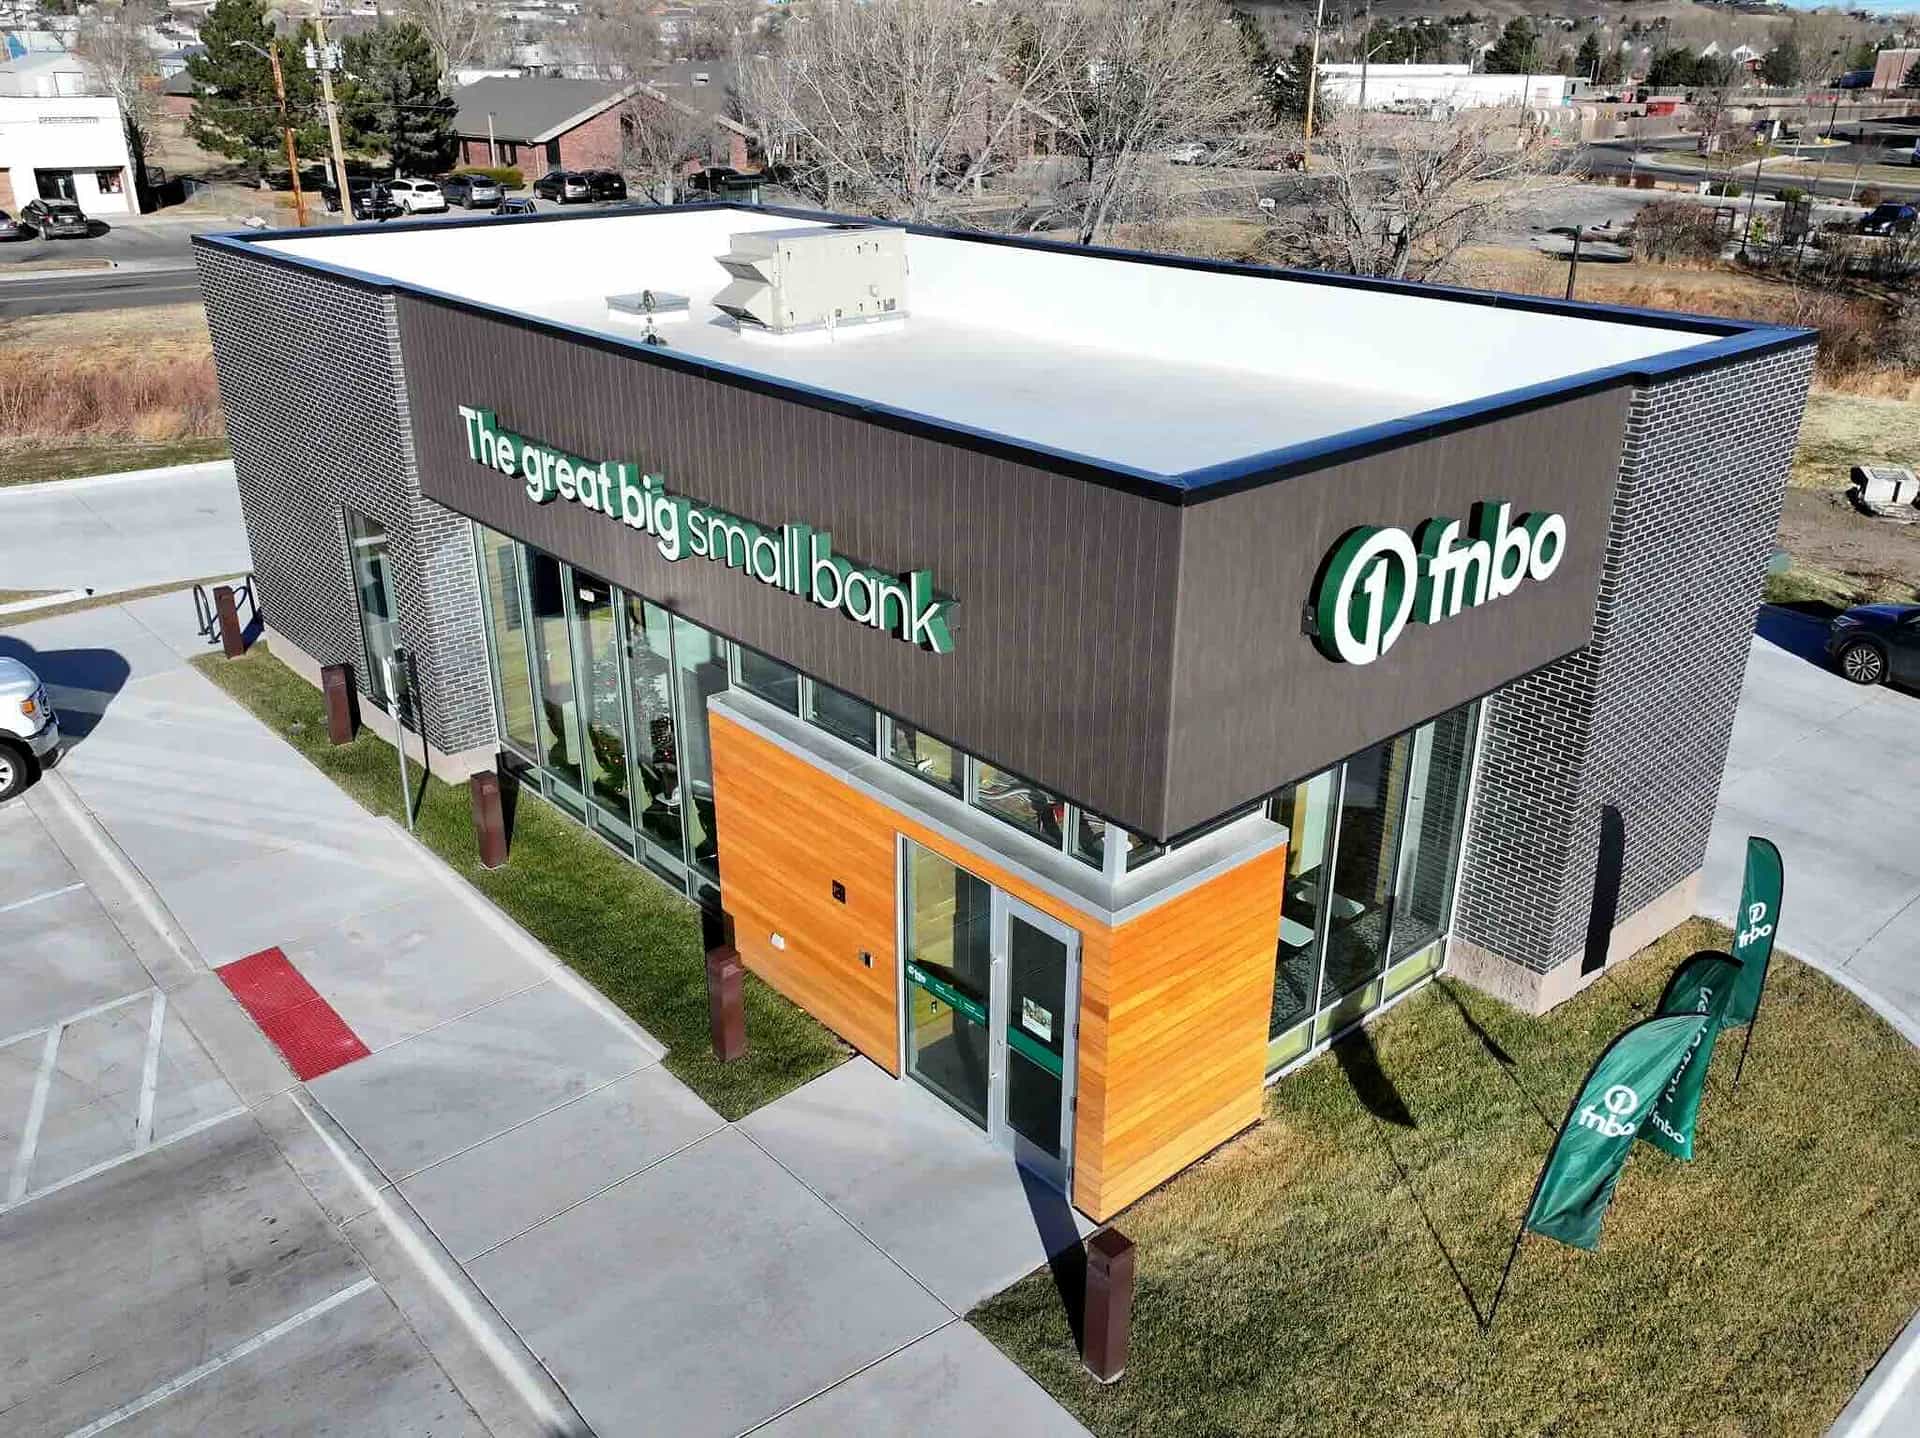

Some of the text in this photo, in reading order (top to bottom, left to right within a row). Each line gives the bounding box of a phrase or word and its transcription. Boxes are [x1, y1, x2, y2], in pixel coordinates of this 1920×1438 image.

[458, 404, 943, 654] The great big small bank
[1428, 502, 1567, 624] fnbo
[1738, 924, 1772, 948] fnbo
[1578, 1104, 1636, 1138] fnbo
